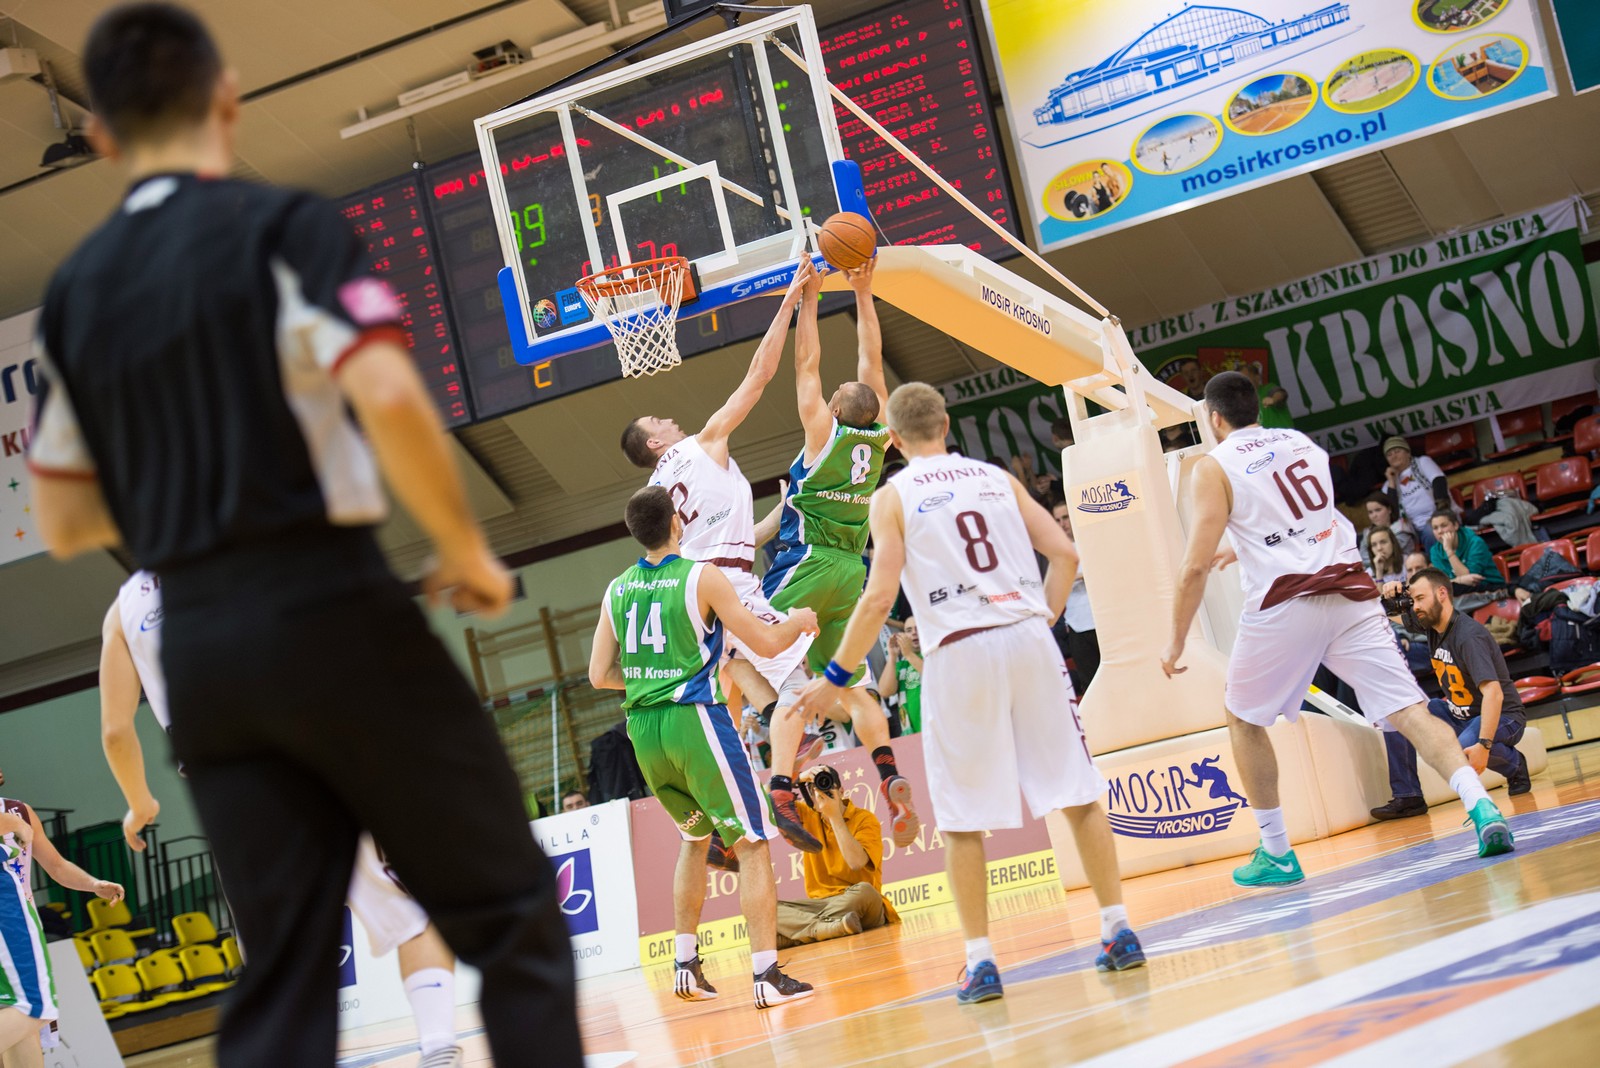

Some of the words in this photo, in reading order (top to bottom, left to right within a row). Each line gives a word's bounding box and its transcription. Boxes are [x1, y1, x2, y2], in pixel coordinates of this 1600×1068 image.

[1181, 112, 1387, 193] mosirkrosno.pl
[754, 272, 788, 290] SPORT
[1127, 311, 1205, 348] LUBU,
[1212, 301, 1229, 324] Z
[1236, 259, 1380, 319] SZACUNKU
[1390, 246, 1428, 275] DO
[1436, 213, 1549, 262] MIASTA
[1013, 303, 1051, 335] KROSNO
[1264, 250, 1585, 418] KROSNO
[1365, 390, 1503, 442] WYRASTA
[850, 442, 873, 486] 8
[1272, 458, 1329, 521] 16
[955, 510, 999, 574] 8
[625, 601, 667, 655] 14
[645, 667, 683, 679] Krosno
[1431, 658, 1474, 707] 78
[1107, 765, 1192, 815] MOSiR
[1155, 813, 1215, 835] KROSNO
